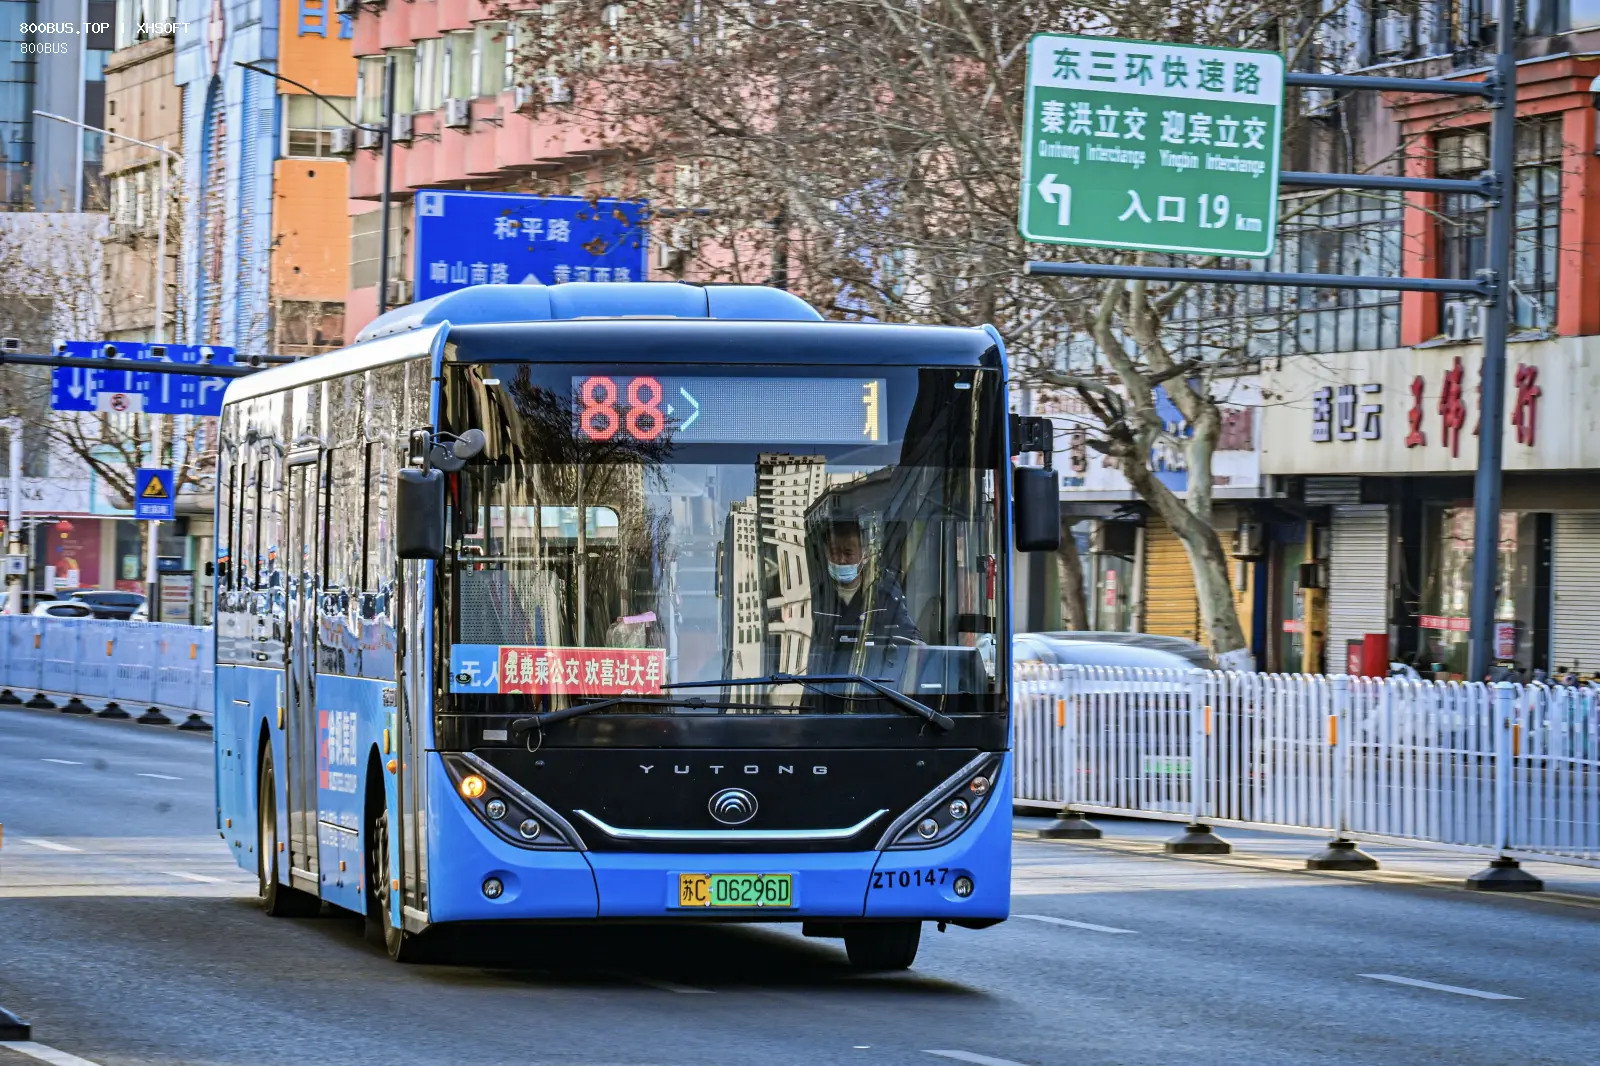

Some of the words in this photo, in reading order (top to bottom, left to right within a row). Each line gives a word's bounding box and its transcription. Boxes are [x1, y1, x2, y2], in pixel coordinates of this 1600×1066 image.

[1052, 47, 1262, 95] 东三环快速路
[1040, 99, 1149, 141] 秦洪立交
[1160, 110, 1268, 150] 迎宾立交
[493, 216, 572, 243] 和平路
[1117, 189, 1187, 224] 入口
[1235, 213, 1263, 232] km
[580, 376, 665, 440] 88
[504, 654, 580, 686] 免费乘公交
[584, 656, 661, 687] 欢喜过大年
[639, 764, 828, 776] YUTONG
[873, 867, 949, 890] ZT0147
